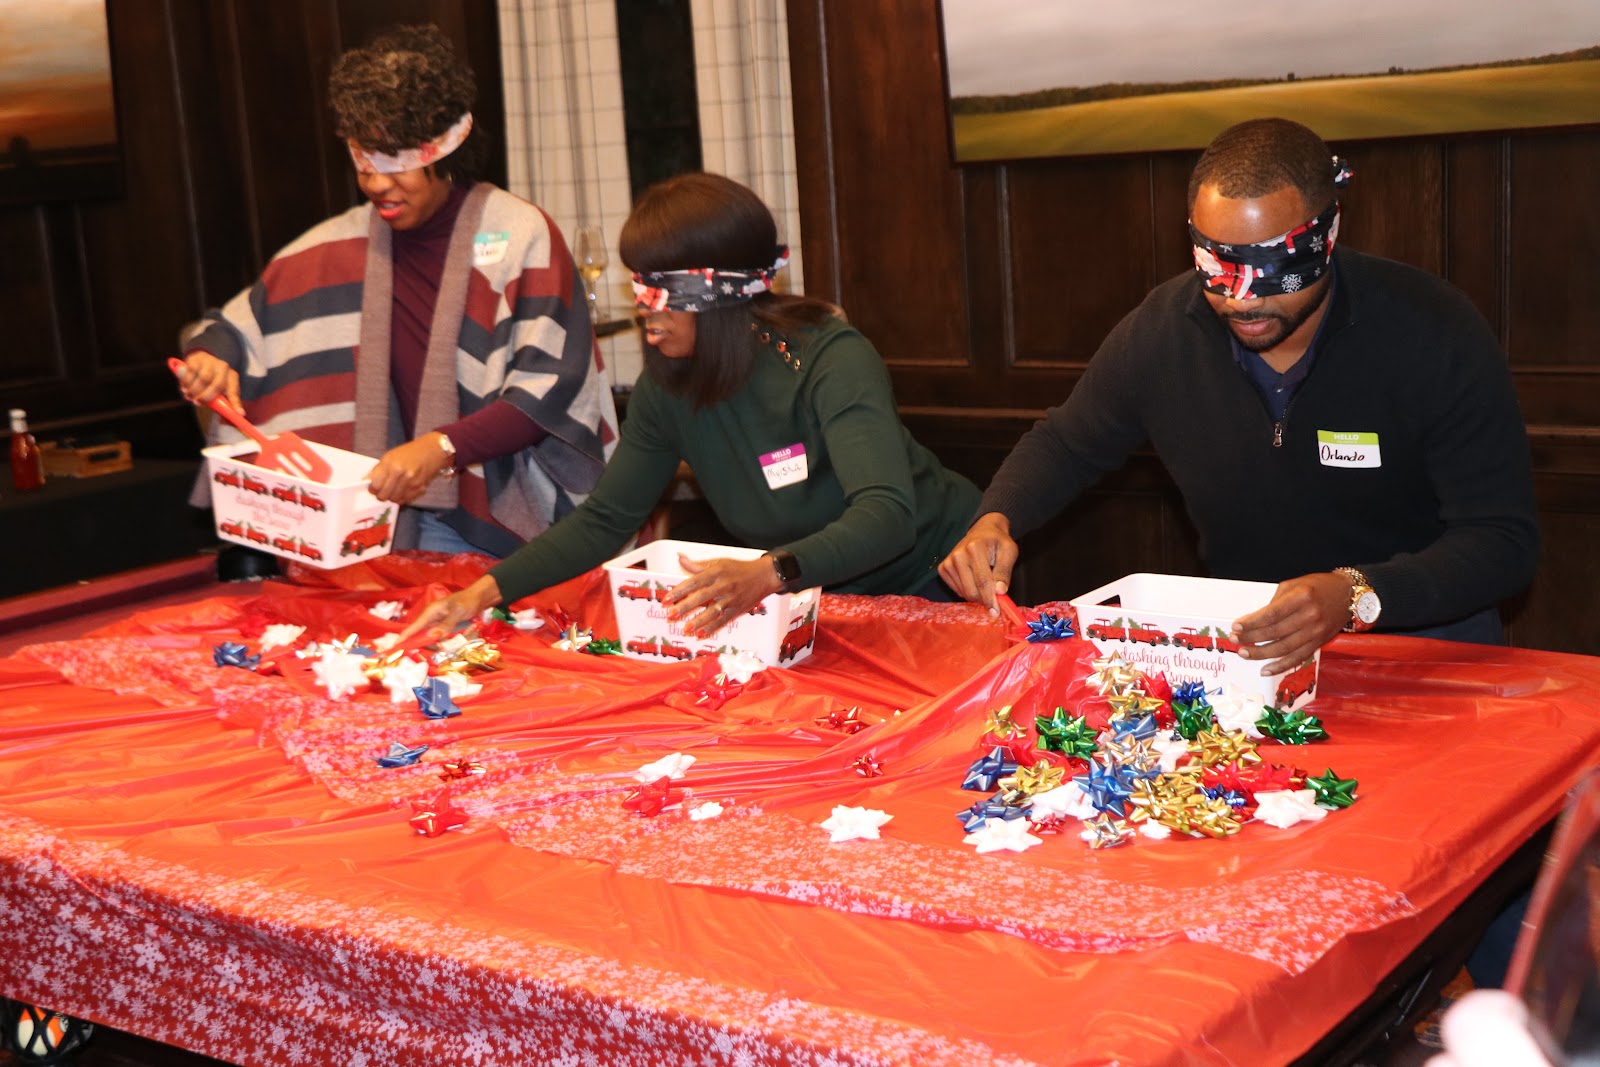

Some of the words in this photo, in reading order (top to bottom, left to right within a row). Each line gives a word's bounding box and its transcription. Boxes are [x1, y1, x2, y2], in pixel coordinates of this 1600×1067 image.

[1333, 433, 1360, 441] HELLO
[771, 448, 792, 459] HELLO
[1321, 444, 1365, 462] Orlando
[1120, 646, 1170, 672] dashing
[1173, 651, 1226, 678] through
